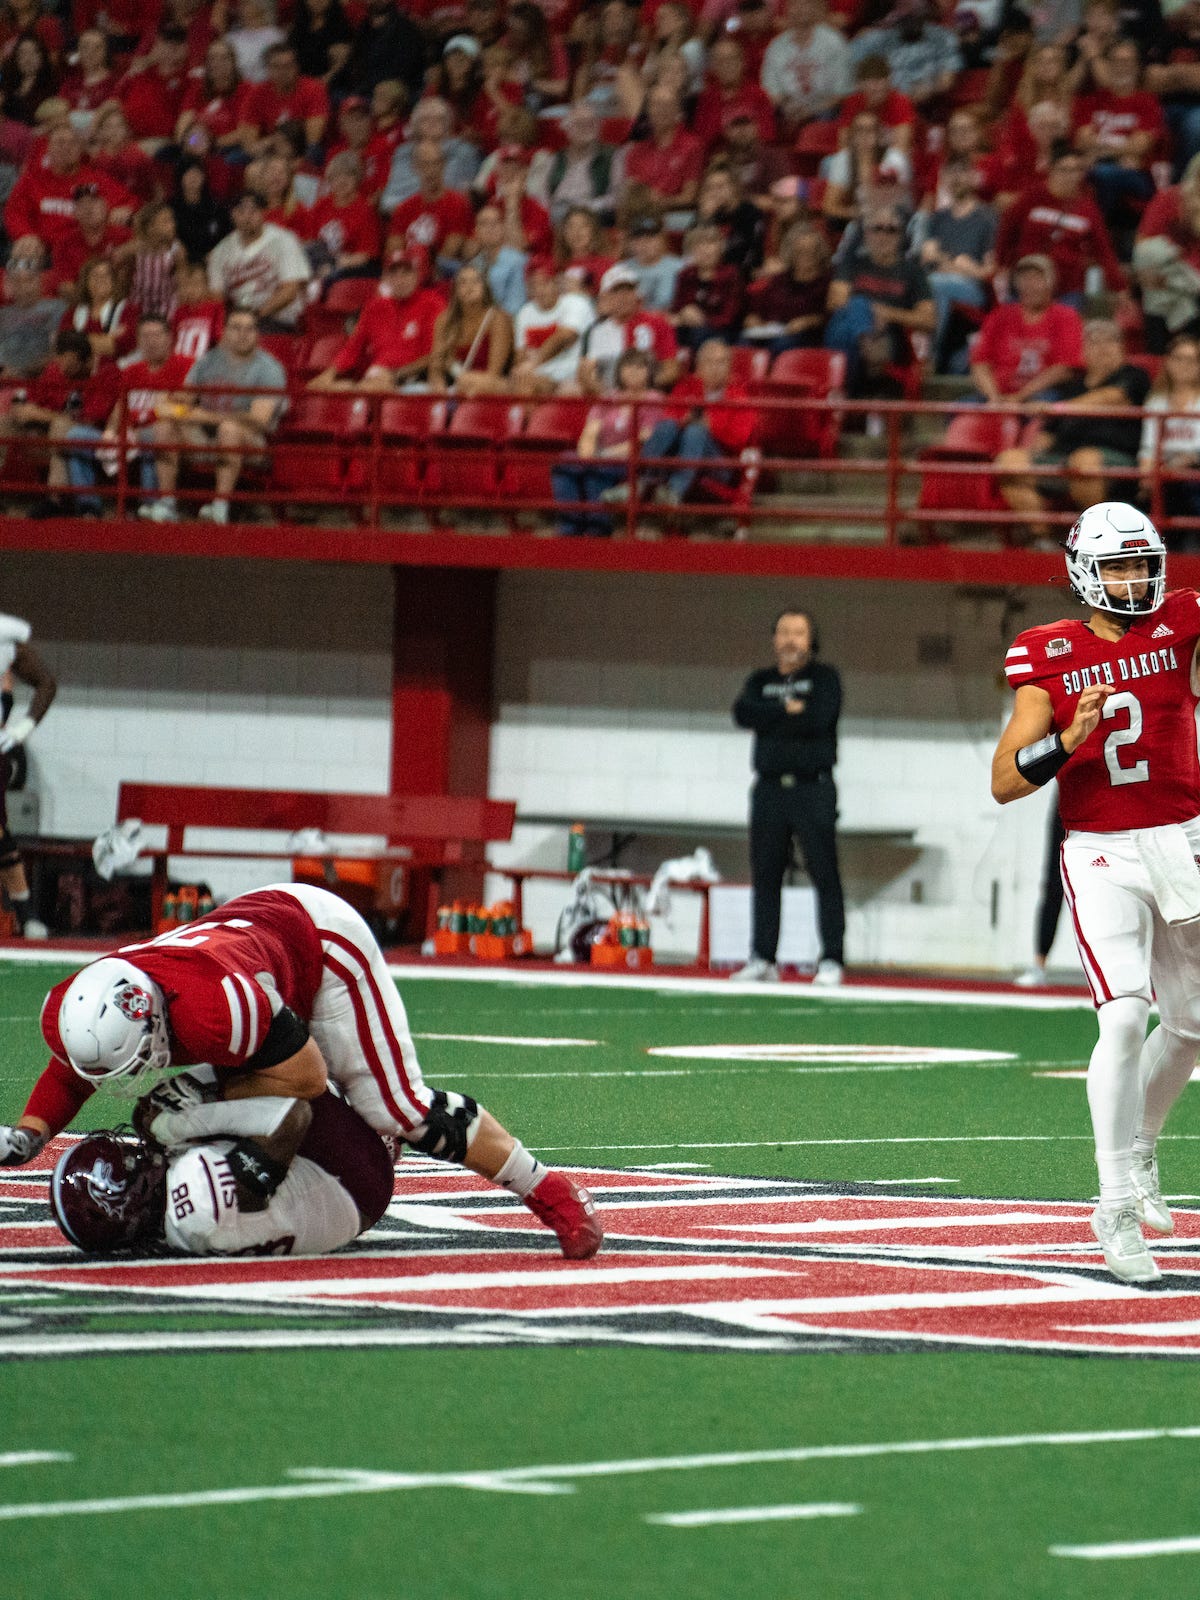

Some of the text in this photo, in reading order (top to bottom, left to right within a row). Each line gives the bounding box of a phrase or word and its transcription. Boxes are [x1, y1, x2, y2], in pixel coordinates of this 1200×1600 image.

[1062, 647, 1178, 695] SOUTH DAKOTA
[1101, 691, 1150, 786] 2
